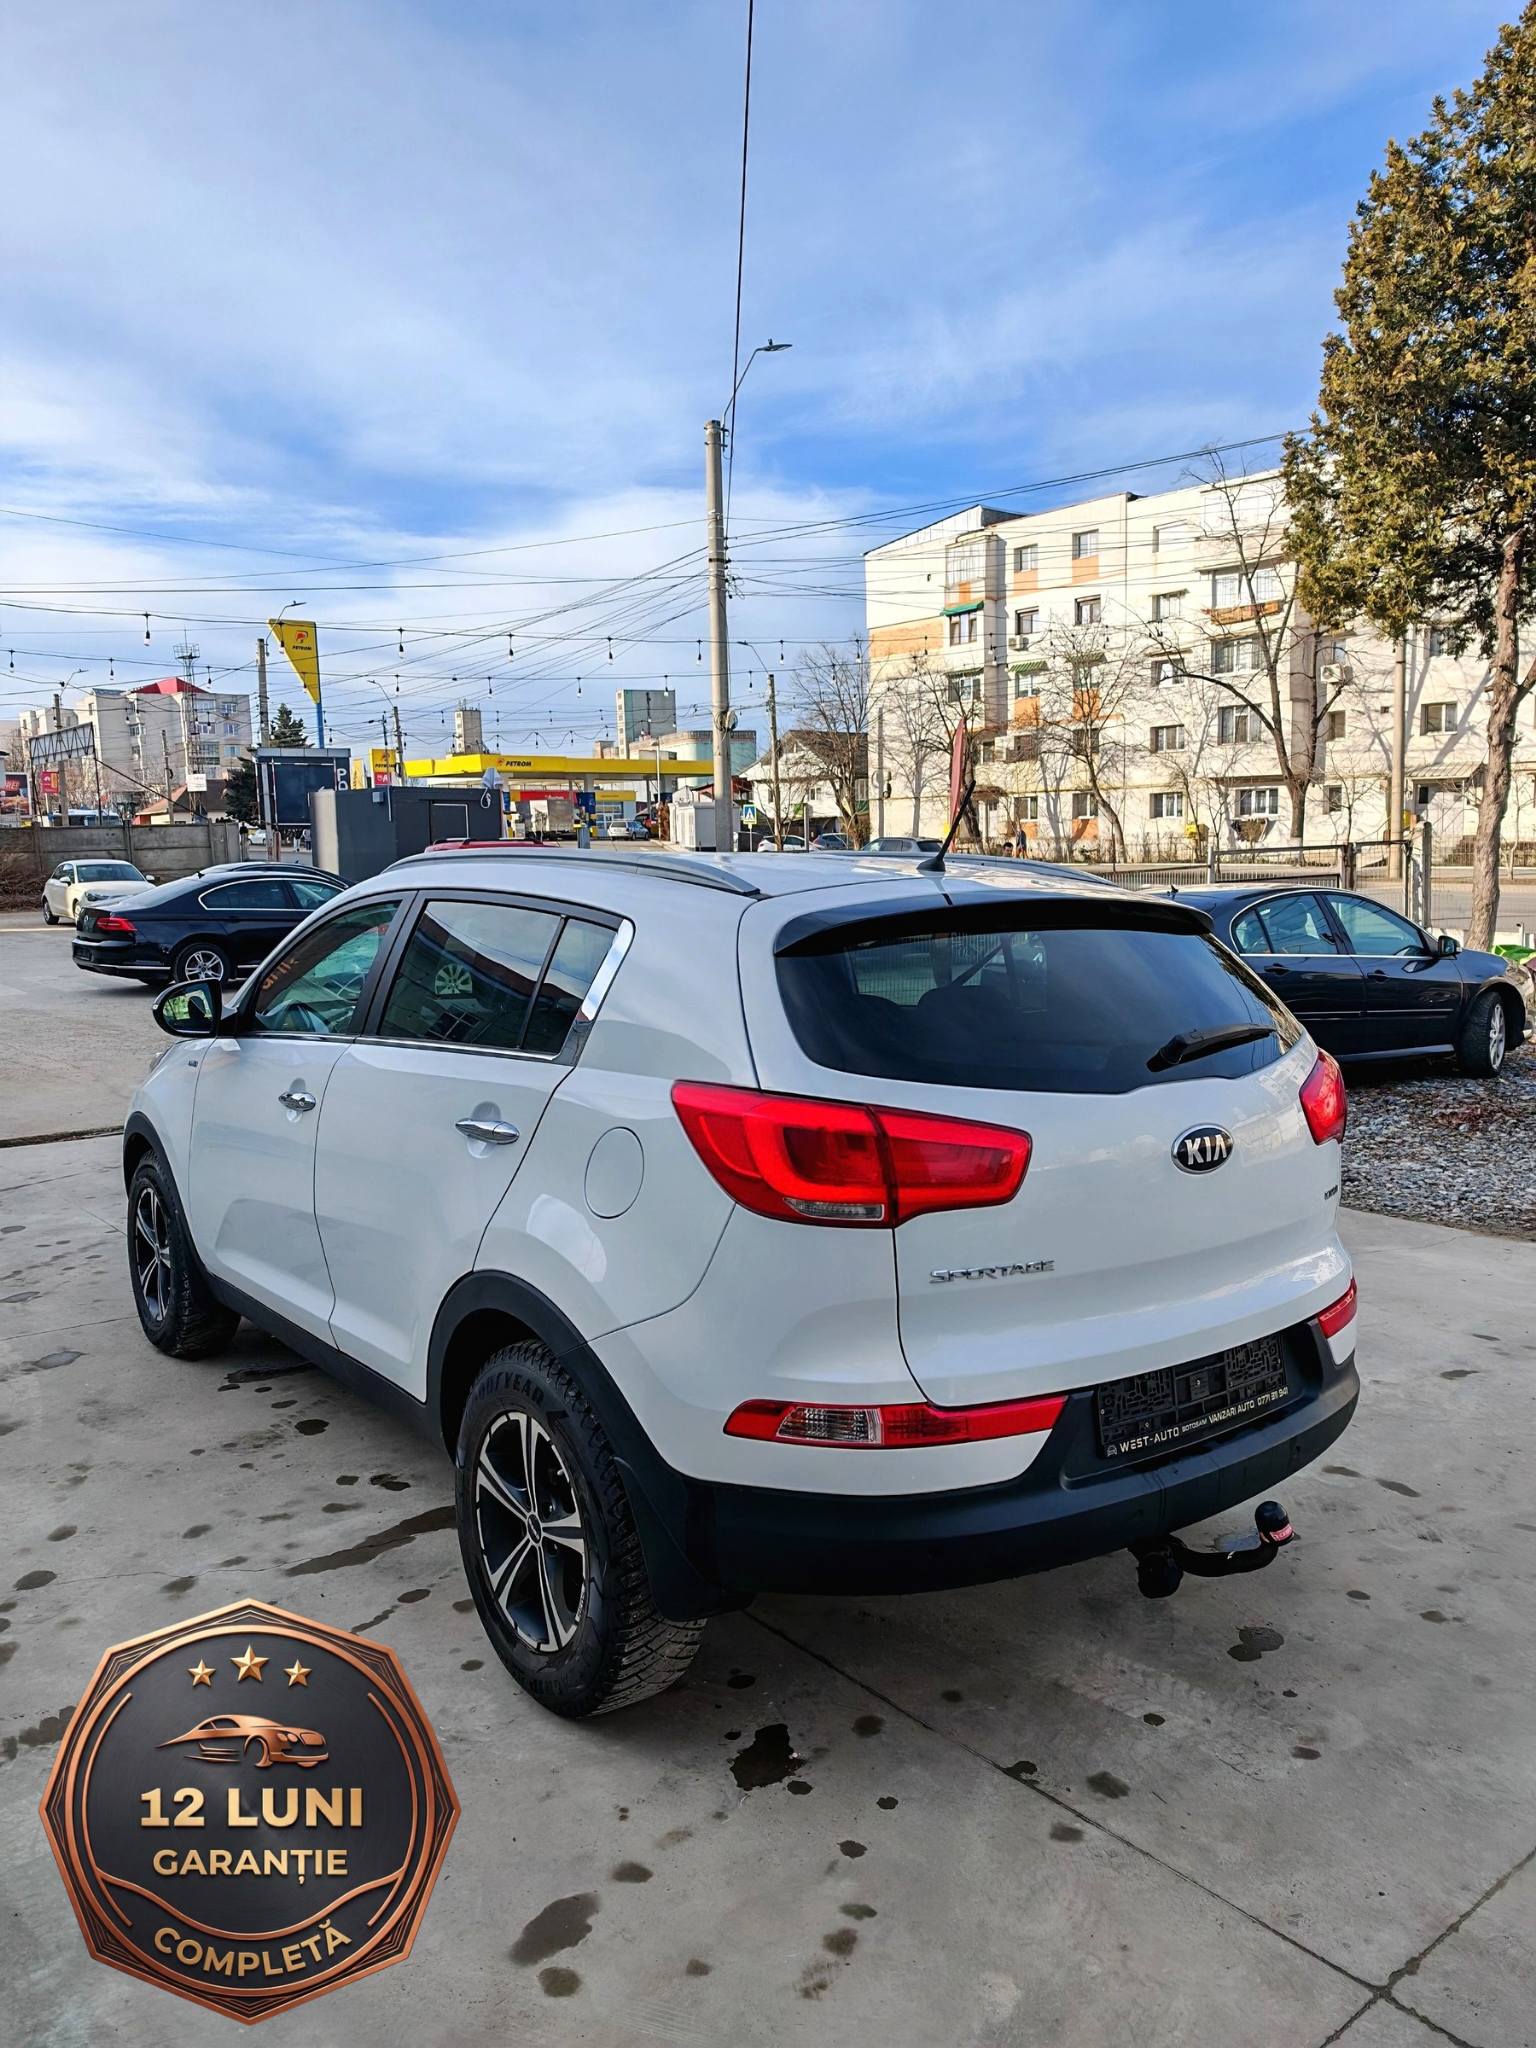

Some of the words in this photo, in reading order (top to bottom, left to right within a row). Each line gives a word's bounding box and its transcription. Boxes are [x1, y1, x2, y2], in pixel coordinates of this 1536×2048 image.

[1185, 1134, 1227, 1165] KIA
[929, 1260, 1055, 1284] SPORTAGE
[1119, 1427, 1179, 1453] WEST-AUTO
[1208, 1406, 1237, 1424] VANZARI
[1237, 1400, 1255, 1414] AUTO
[1257, 1393, 1271, 1406] 0771
